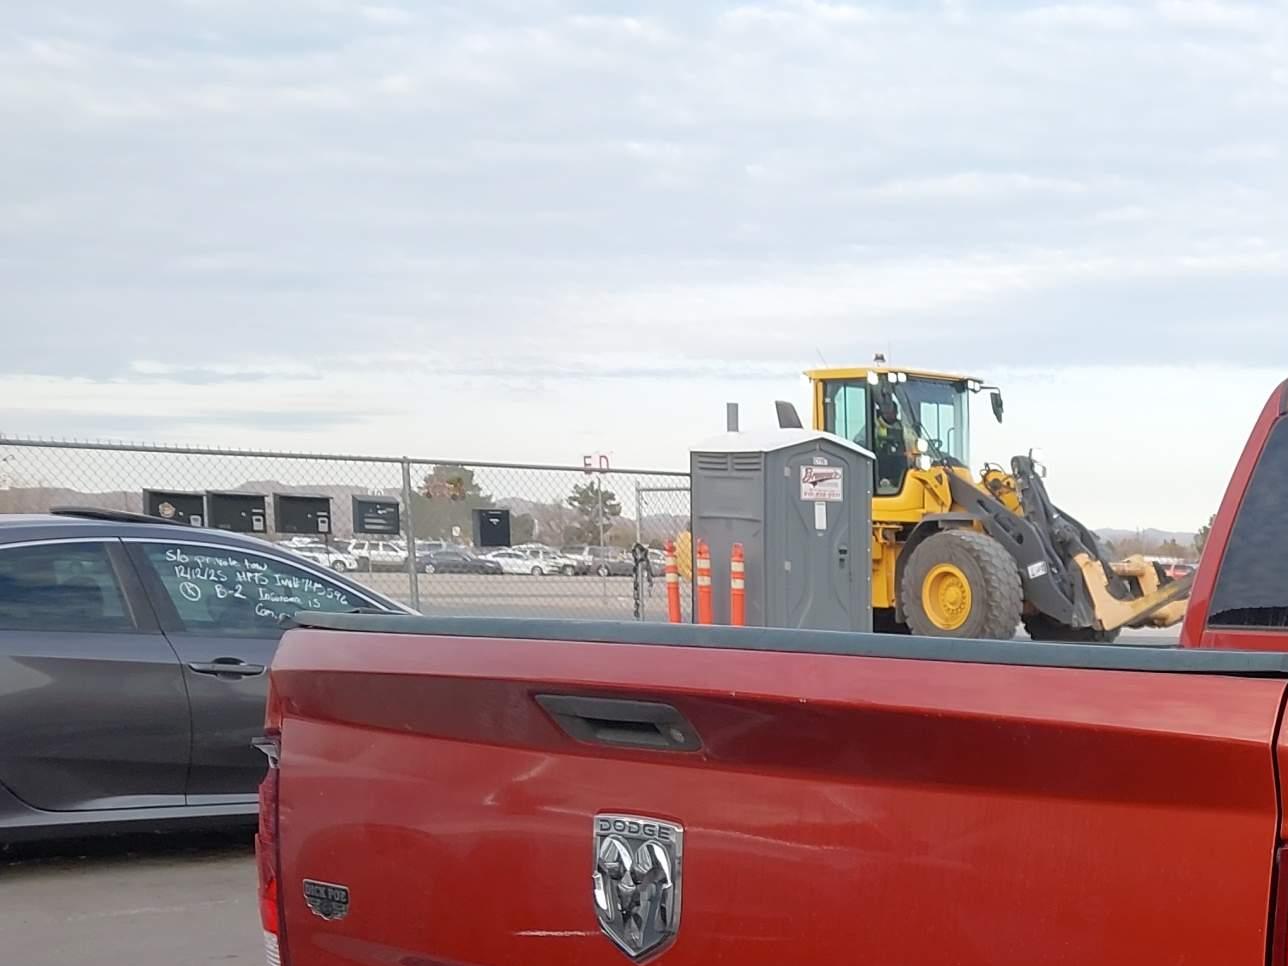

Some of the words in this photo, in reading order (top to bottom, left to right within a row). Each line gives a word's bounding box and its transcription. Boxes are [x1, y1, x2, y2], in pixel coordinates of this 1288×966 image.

[174, 565, 228, 582] 12/12/25
[215, 584, 247, 600] B-2
[599, 819, 672, 841] DODGE
